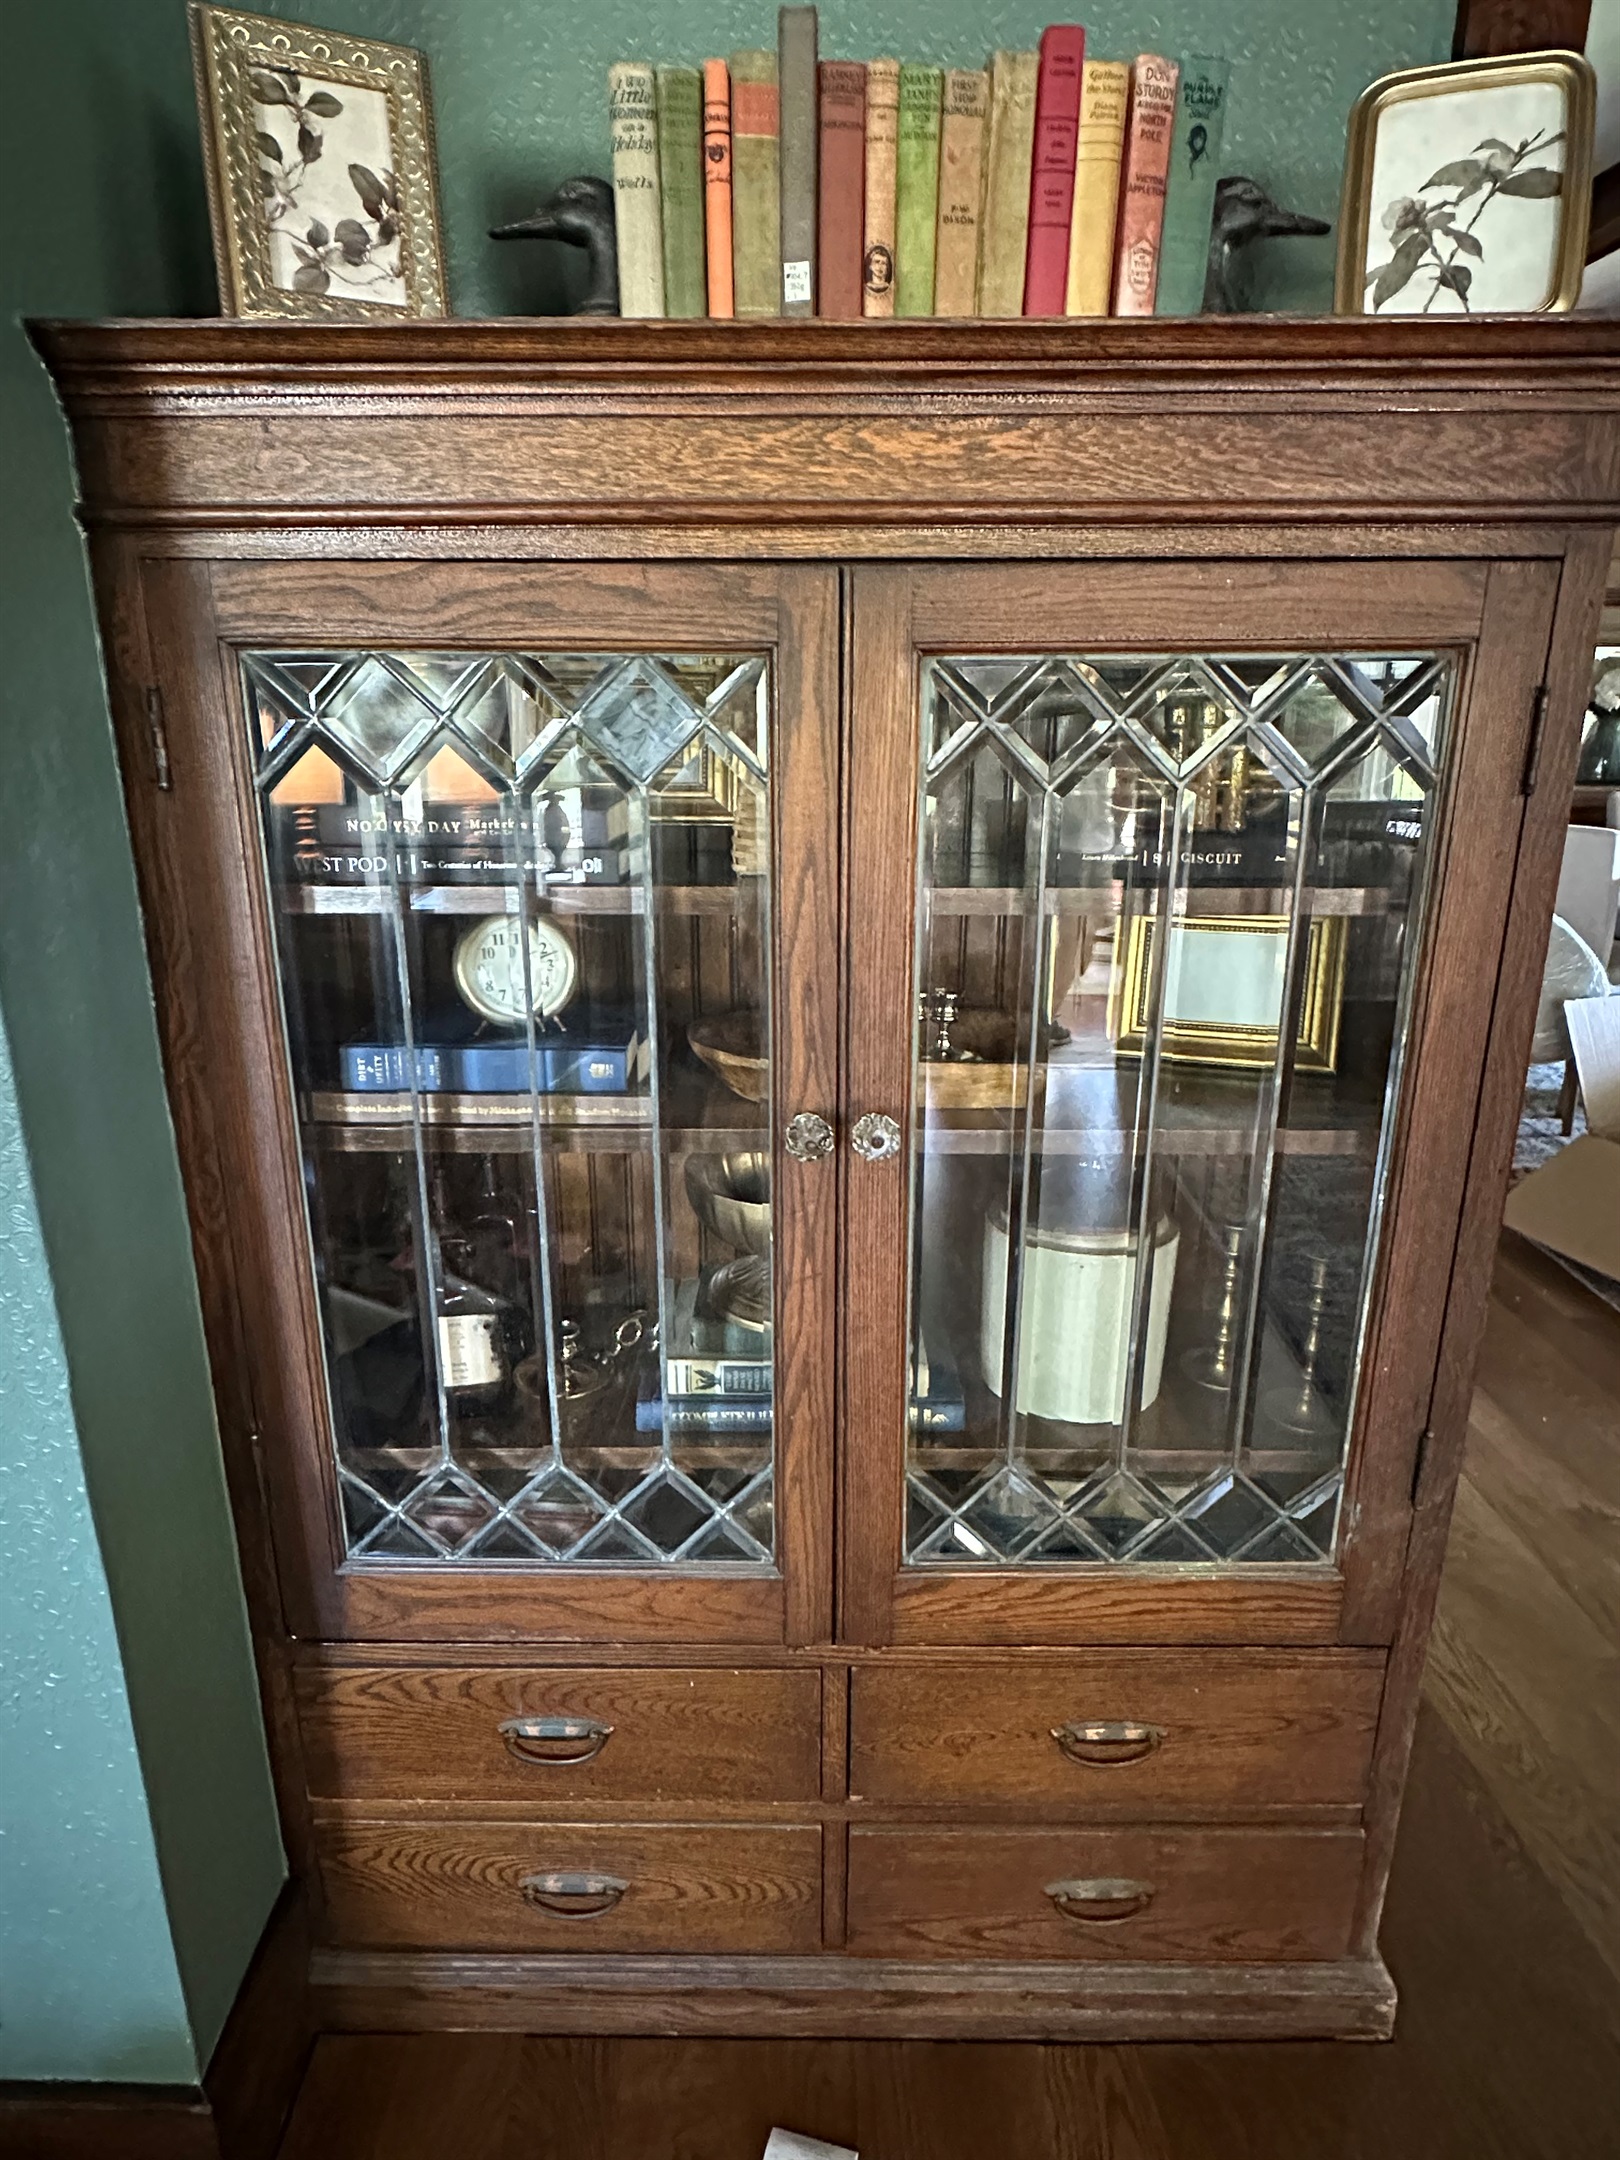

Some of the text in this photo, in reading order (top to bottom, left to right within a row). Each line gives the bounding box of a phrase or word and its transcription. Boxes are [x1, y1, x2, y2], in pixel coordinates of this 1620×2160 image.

[1146, 67, 1171, 82] DON
[1136, 84, 1175, 102] STURDY
[1140, 113, 1167, 127] NORTH
[1140, 128, 1162, 144] POLE
[943, 215, 974, 225] DIXON
[428, 821, 461, 833] DAY
[493, 934, 504, 946] 11
[482, 948, 495, 960] 10
[485, 980, 507, 1001] 8 7
